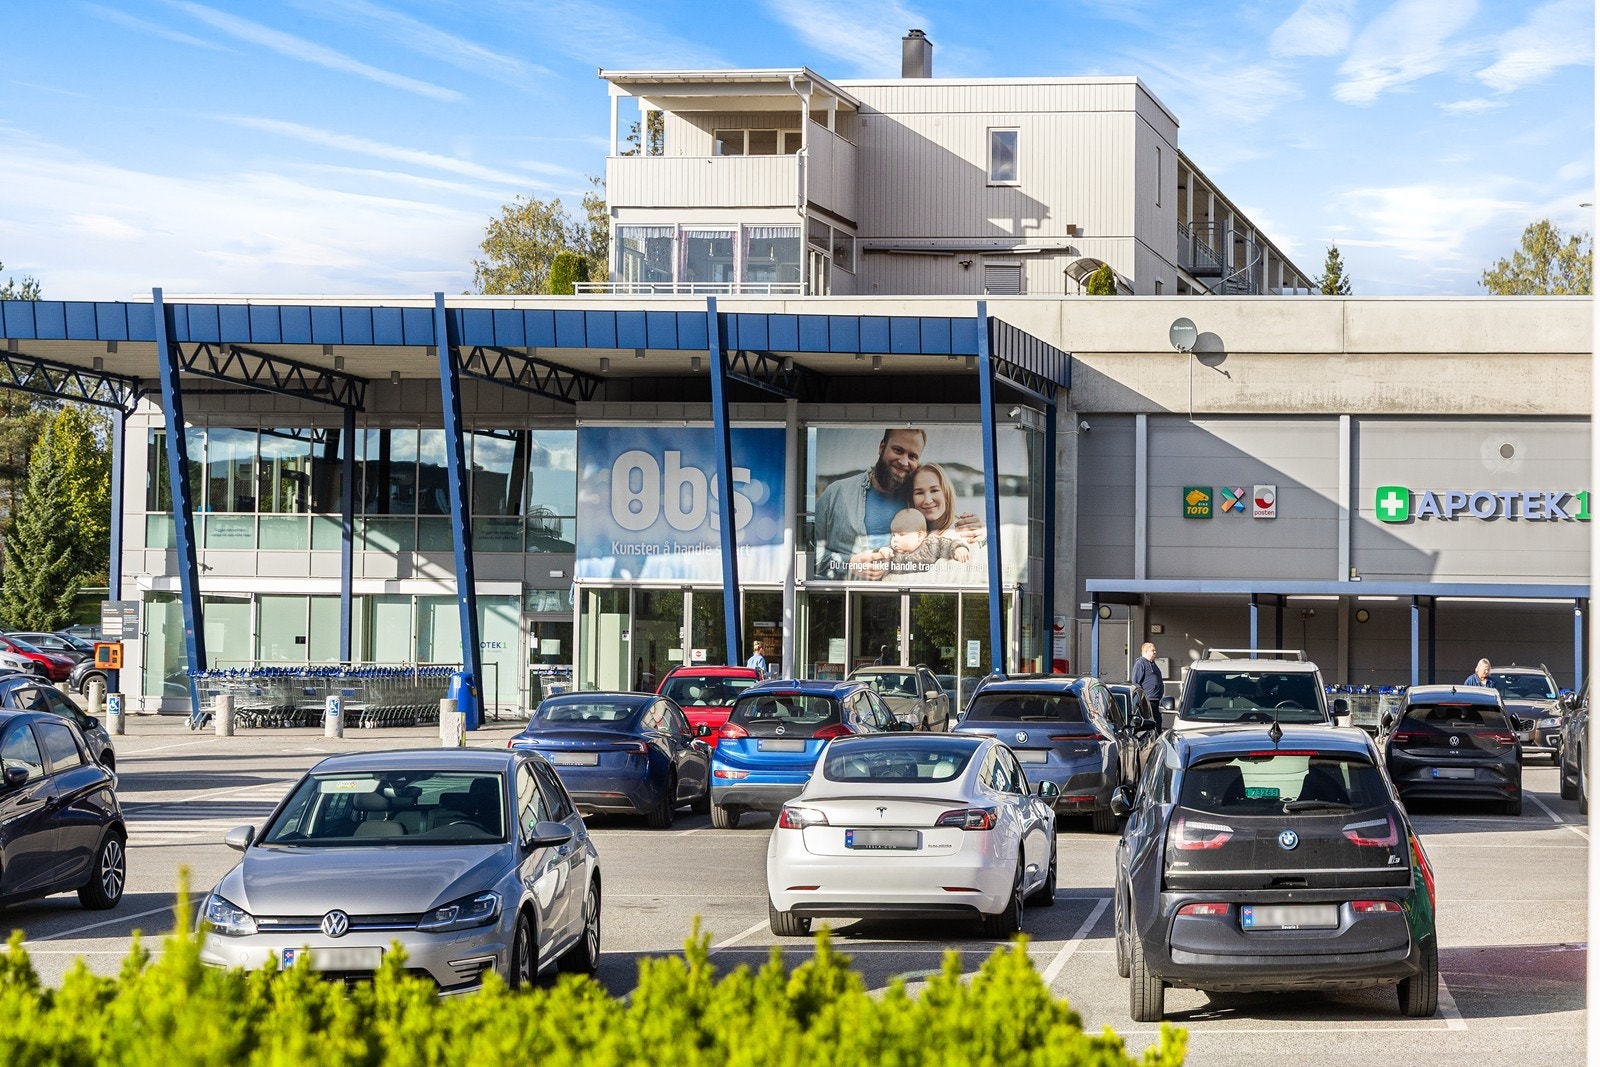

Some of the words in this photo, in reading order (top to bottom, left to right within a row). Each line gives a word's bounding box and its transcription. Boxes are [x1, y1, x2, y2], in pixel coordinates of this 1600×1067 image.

[611, 450, 753, 531] Obs
[1187, 506, 1209, 514] TOTO
[1416, 490, 1569, 519] APOTEK
[1574, 490, 1591, 519] 1
[611, 541, 660, 555] Kunsten
[663, 541, 670, 555] å
[673, 542, 712, 556] handle
[829, 560, 840, 570] Du
[842, 561, 870, 572] trenger
[872, 560, 889, 570] ikke
[890, 561, 917, 571] handle
